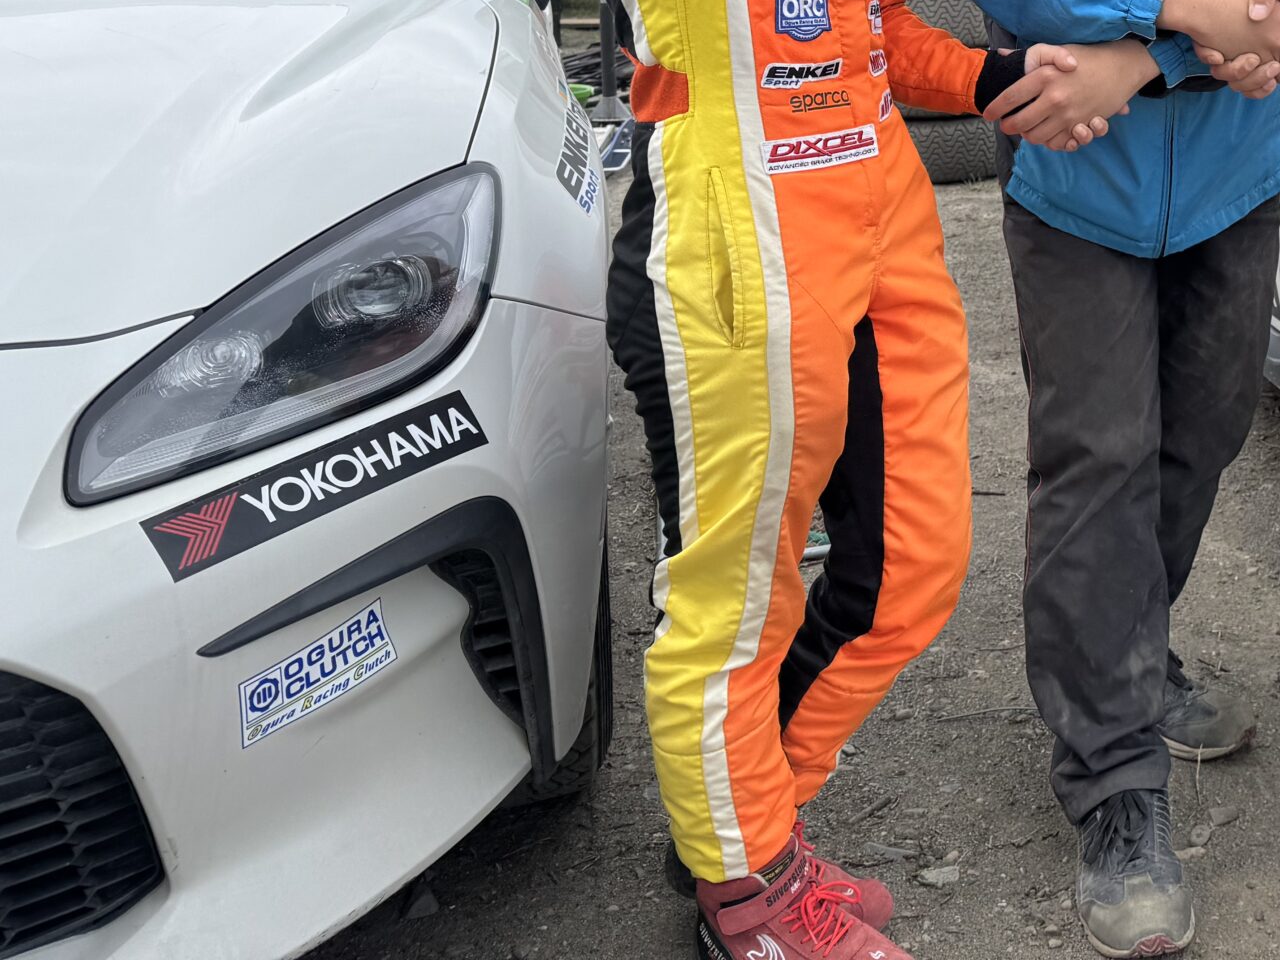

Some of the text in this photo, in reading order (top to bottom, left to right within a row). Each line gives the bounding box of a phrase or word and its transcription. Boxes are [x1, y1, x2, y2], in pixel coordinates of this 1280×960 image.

[763, 77, 800, 87] Sport
[765, 61, 840, 80] ENKEI
[790, 90, 850, 113] sparco
[768, 129, 875, 160] DIXCEL
[240, 407, 479, 523] YOKOHAMA
[284, 608, 380, 680] OGURA
[285, 624, 386, 700] CLUTCH
[247, 648, 391, 741] Ogura Racing Clutch
